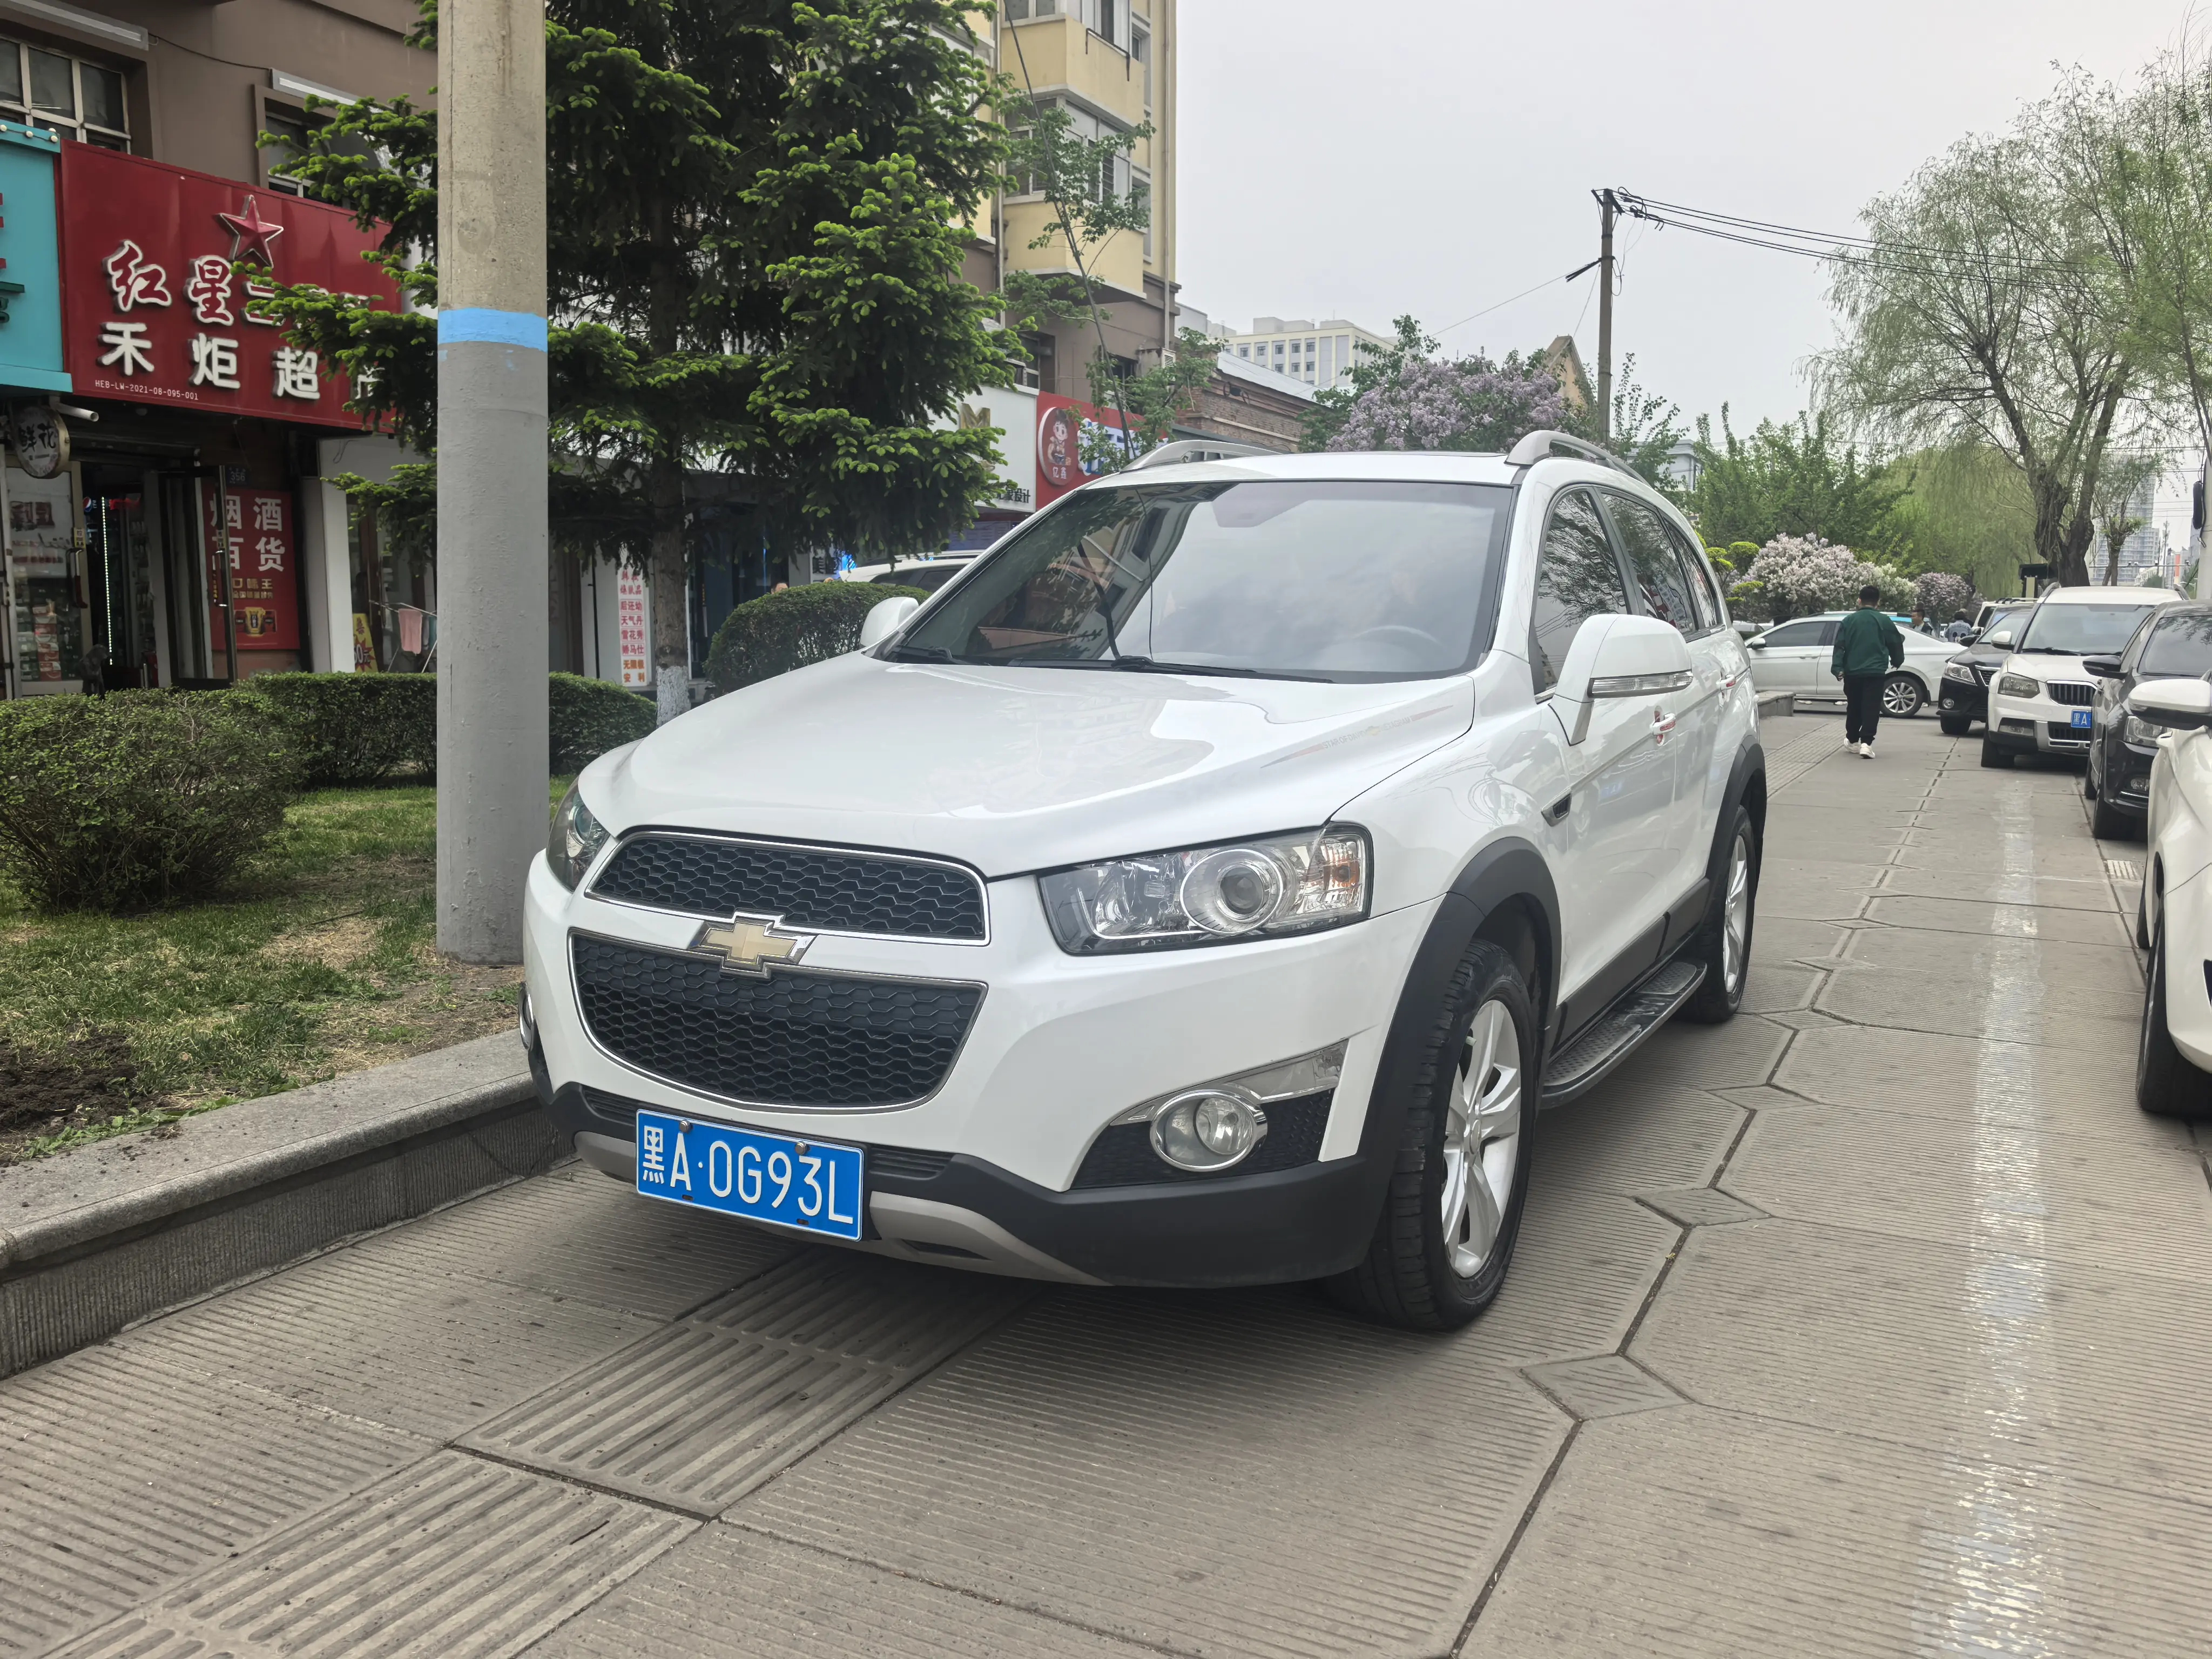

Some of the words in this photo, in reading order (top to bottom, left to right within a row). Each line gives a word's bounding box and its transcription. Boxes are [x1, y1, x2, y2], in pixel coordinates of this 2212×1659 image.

[18, 421, 57, 453] 鲜花
[230, 471, 245, 482] 356
[1053, 466, 1067, 479] 亿鑫
[621, 615, 643, 625] 天气丹
